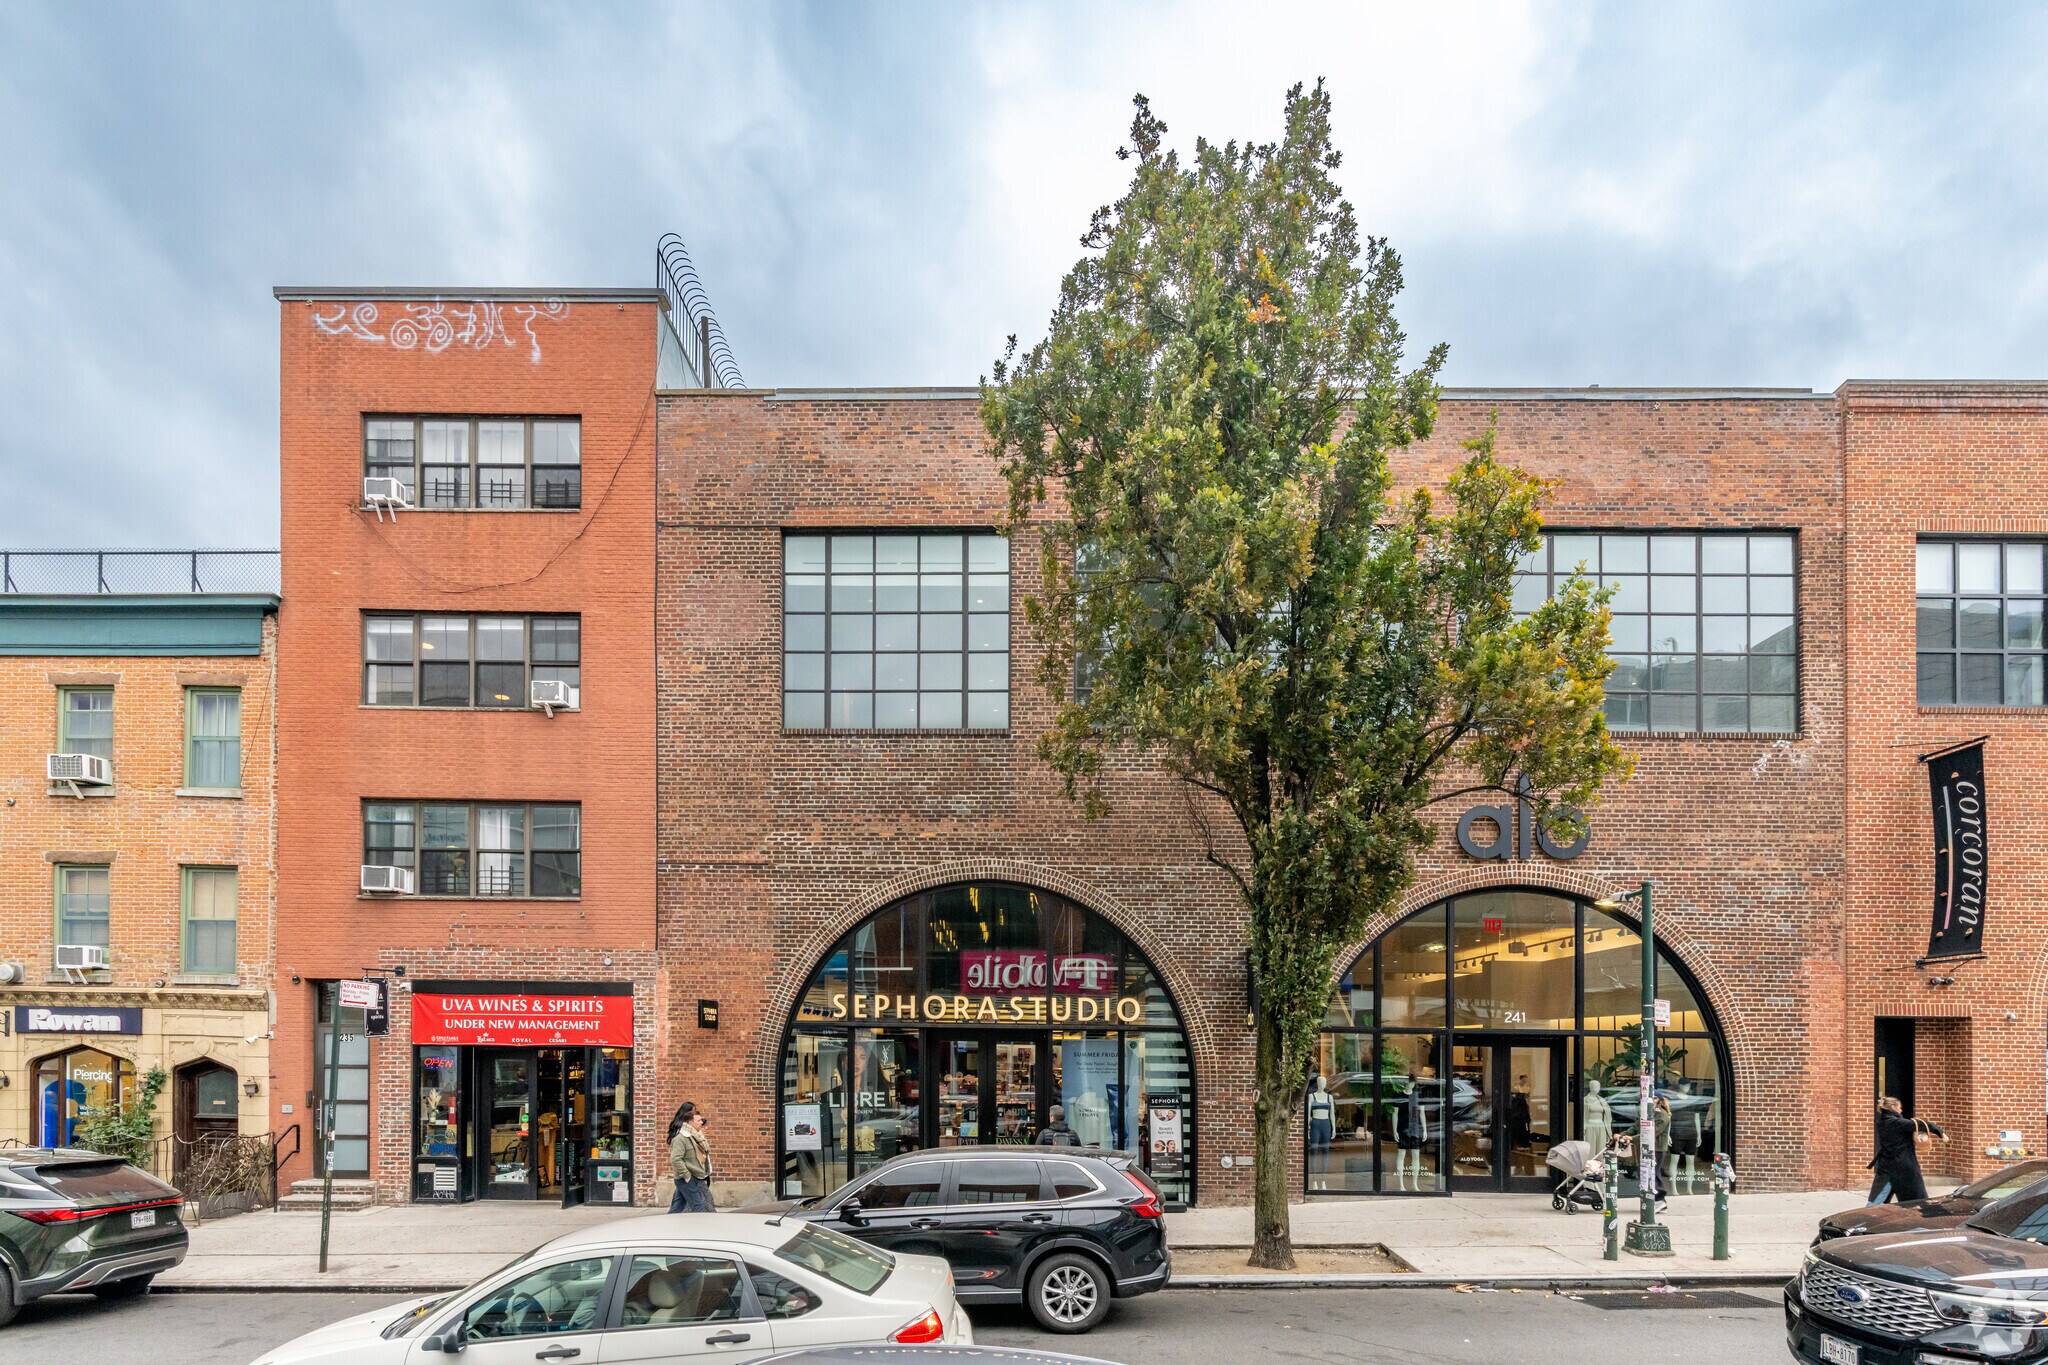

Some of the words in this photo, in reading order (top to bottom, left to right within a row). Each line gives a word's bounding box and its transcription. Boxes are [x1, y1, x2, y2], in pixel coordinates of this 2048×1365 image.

[1956, 781, 1982, 924] corcoran
[442, 998, 474, 1011] UVA
[478, 998, 528, 1012] WINES
[532, 1000, 543, 1011] &
[548, 1000, 604, 1013] SPIRITS
[833, 994, 999, 1020] SEPHORA
[1010, 997, 1141, 1022] STUDIO
[28, 1008, 121, 1031] Rowan
[445, 1018, 486, 1029] UNDER
[488, 1019, 516, 1029] NEW
[517, 1019, 601, 1031] MANAGEMENT
[1504, 1011, 1526, 1024] 241
[339, 1033, 354, 1042] 235
[423, 1057, 454, 1069] OPEN
[73, 1069, 112, 1083] Piercing
